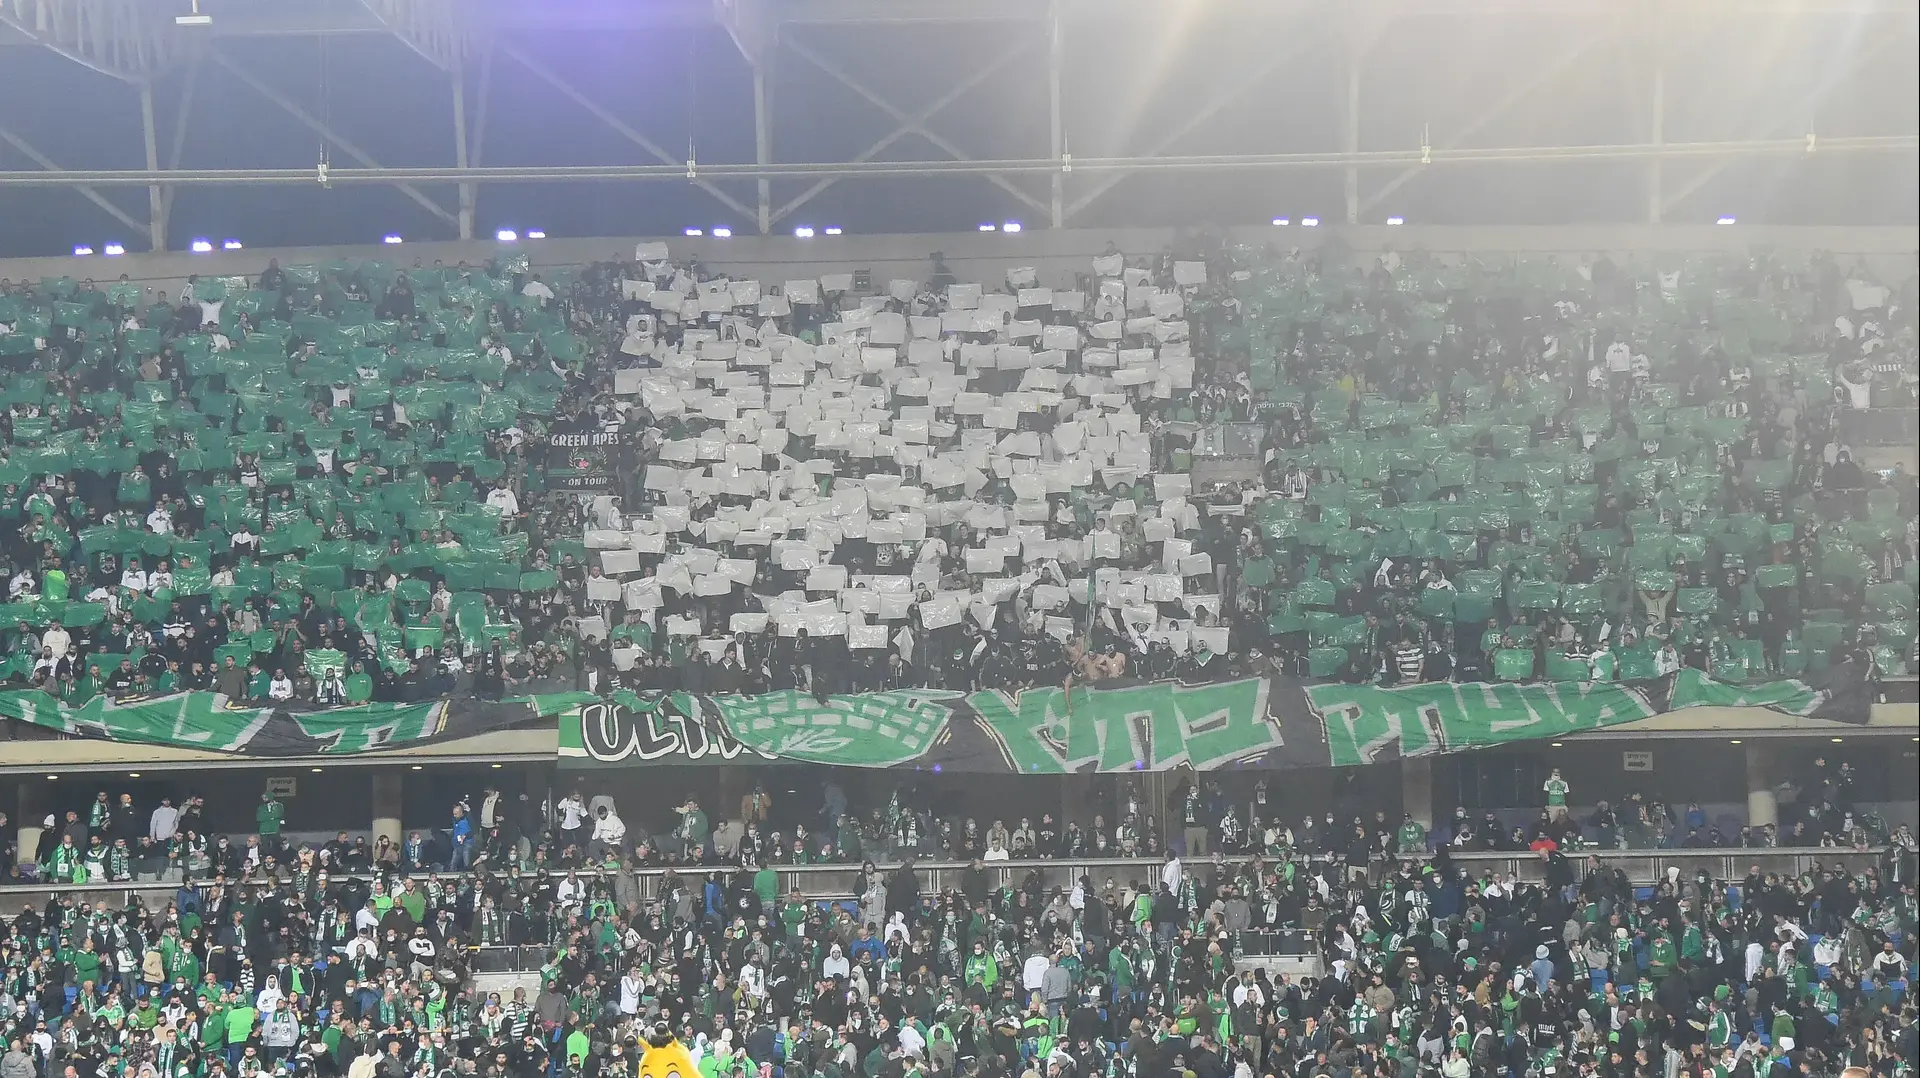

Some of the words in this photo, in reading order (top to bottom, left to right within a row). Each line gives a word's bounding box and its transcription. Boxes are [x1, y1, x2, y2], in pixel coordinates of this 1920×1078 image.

[551, 434, 589, 447] GREEN
[592, 432, 620, 446] APES
[568, 478, 581, 486] ON
[584, 477, 608, 486] TOUR
